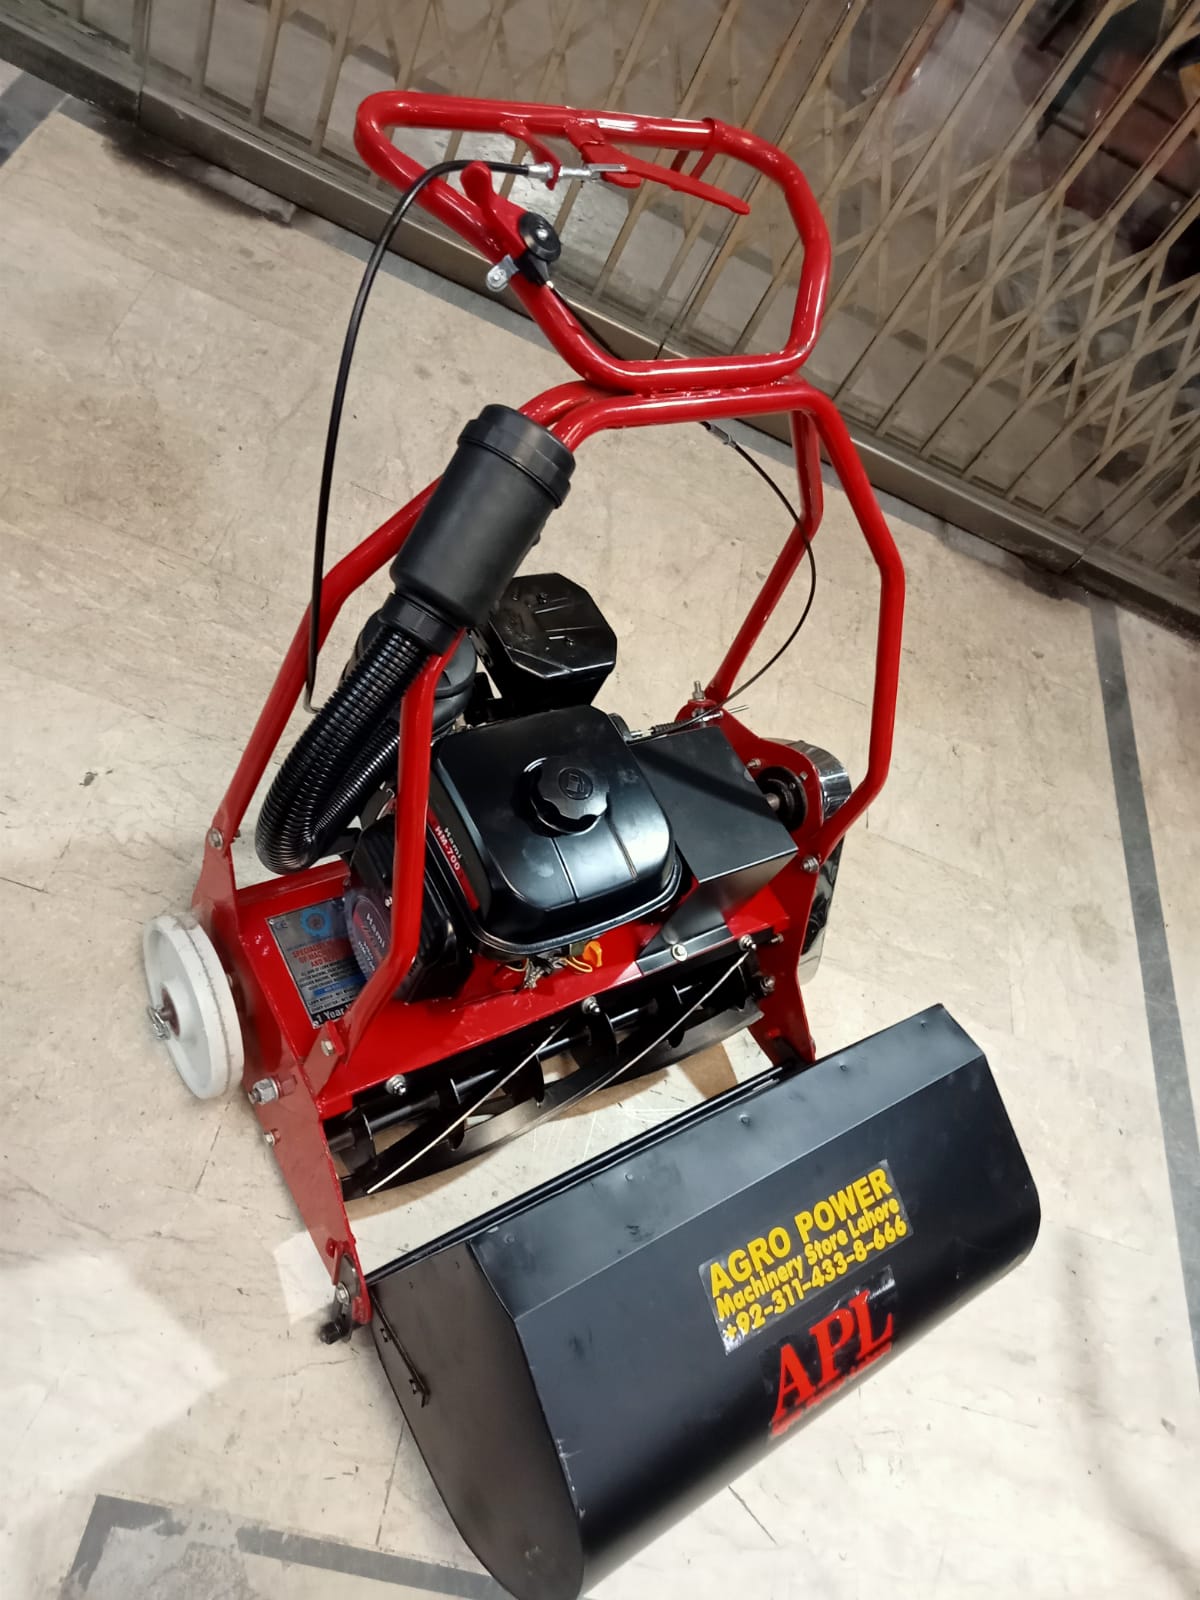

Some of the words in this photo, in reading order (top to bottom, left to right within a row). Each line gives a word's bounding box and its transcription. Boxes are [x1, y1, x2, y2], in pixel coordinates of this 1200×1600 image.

[434, 825, 460, 871] HM-700
[316, 1013, 323, 1023] 1
[323, 1008, 345, 1019] Year
[709, 1226, 791, 1298] AGRO
[794, 1168, 893, 1243] POWER
[715, 1255, 803, 1322] Machinery
[804, 1229, 848, 1265] Store
[847, 1197, 900, 1239] Lahore
[722, 1215, 908, 1341] +92-311-433-8-666
[772, 1289, 893, 1425] APL
